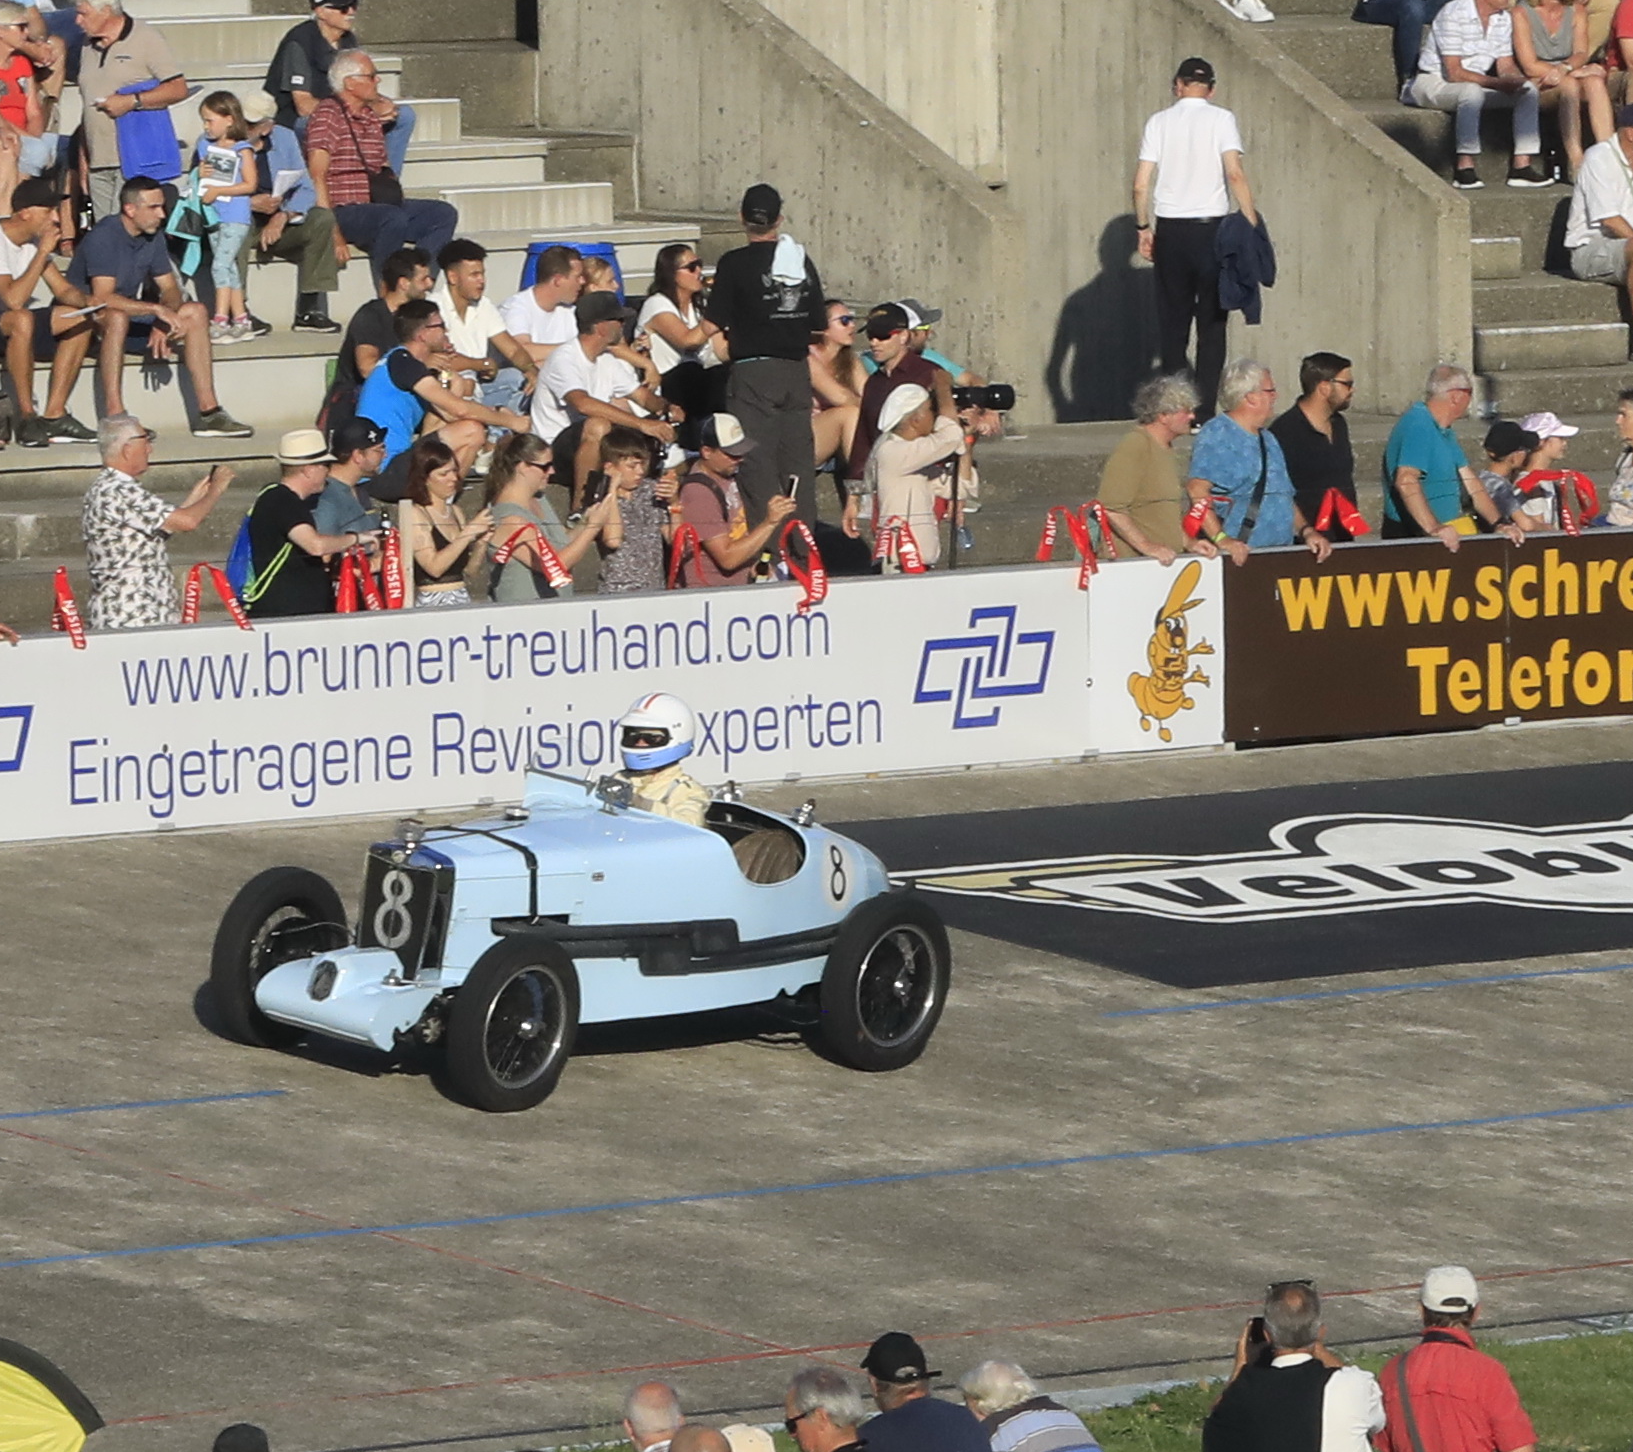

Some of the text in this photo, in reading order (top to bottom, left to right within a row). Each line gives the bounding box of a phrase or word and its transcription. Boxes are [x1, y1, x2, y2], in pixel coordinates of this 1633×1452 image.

[121, 601, 830, 707] www.brunner-treuhand.com
[70, 732, 412, 818] Eingetragene
[374, 869, 413, 950] 8
[830, 844, 845, 901] 8
